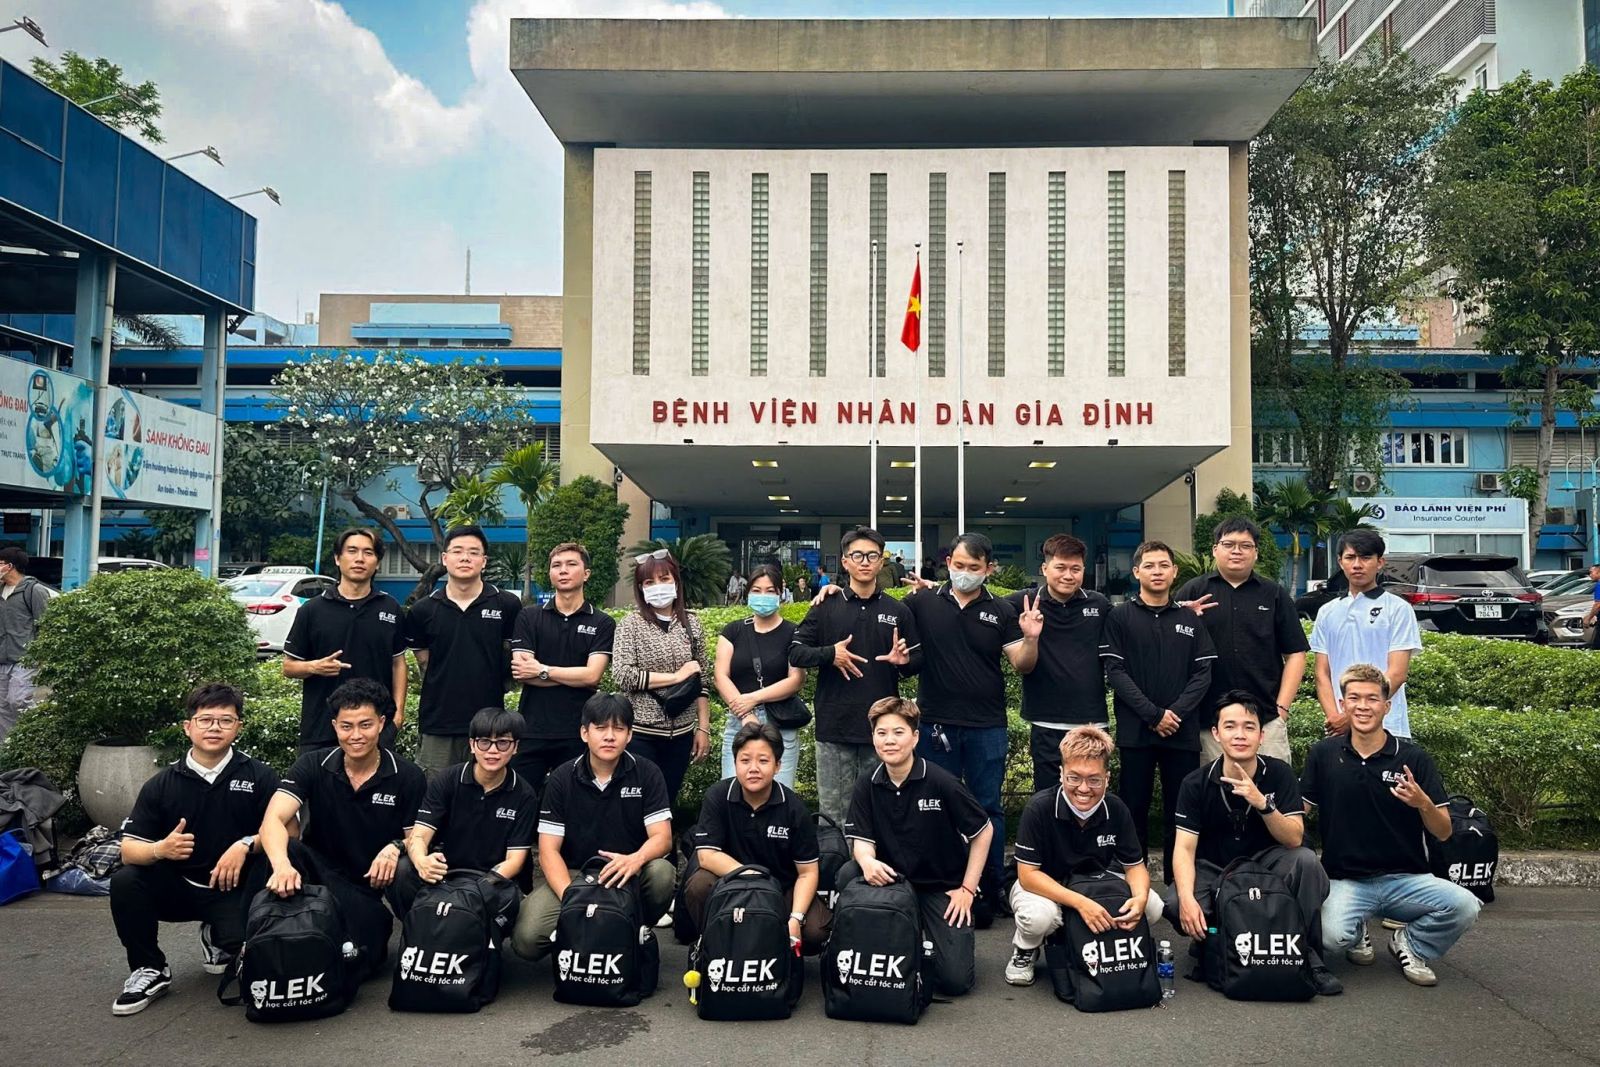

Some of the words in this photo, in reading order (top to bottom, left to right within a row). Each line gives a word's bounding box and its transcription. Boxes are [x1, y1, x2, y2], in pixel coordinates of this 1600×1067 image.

[14, 398, 28, 413] ĐAU
[652, 397, 728, 427] BỆNH
[749, 397, 817, 427] VIỆN
[837, 398, 915, 424] NHÂN
[936, 399, 994, 425] DÂN
[1015, 399, 1063, 426] GIA
[1083, 398, 1152, 428] ĐỊNH
[168, 433, 194, 452] KHÔNG
[196, 440, 211, 456] ĐAU
[1394, 503, 1417, 512] BẢO
[1421, 503, 1451, 512] LÃNH
[1455, 503, 1482, 514] VIỆN
[1486, 503, 1507, 512] PHÍ
[883, 614, 898, 623] LEK
[985, 612, 998, 622] LEK
[1180, 625, 1194, 634] LEK
[235, 780, 254, 790] LEK
[378, 793, 396, 803] LEK
[924, 799, 941, 808] LEK
[772, 826, 790, 836] LEK
[1102, 834, 1116, 843] LEK
[1462, 861, 1494, 880] LEK
[1099, 936, 1143, 963] LEK
[1254, 933, 1302, 956] LEK
[414, 949, 470, 975] LEK
[572, 952, 623, 975] LEK
[853, 952, 906, 978] LEK
[1251, 957, 1264, 966] học
[1267, 956, 1279, 965] cắt
[1282, 957, 1293, 965] tóc
[725, 958, 778, 982] LEK
[1100, 965, 1112, 974] học
[1114, 962, 1126, 972] cắt
[1128, 962, 1138, 970] tóc
[410, 972, 422, 982] học
[424, 974, 437, 984] cắt
[438, 977, 450, 985] tóc
[452, 977, 466, 985] nét
[569, 974, 582, 982] học
[584, 976, 596, 984] cắt
[598, 977, 609, 985] tóc
[848, 976, 862, 985] học
[864, 976, 877, 986] cắt
[879, 980, 891, 988] tóc
[269, 972, 325, 1000] LEK
[721, 984, 735, 992] học
[737, 982, 750, 992] cắt
[752, 984, 764, 992] tóc
[766, 982, 778, 990] nét
[266, 1000, 280, 1009] học
[282, 999, 296, 1007] cắt
[299, 998, 312, 1006] tóc
